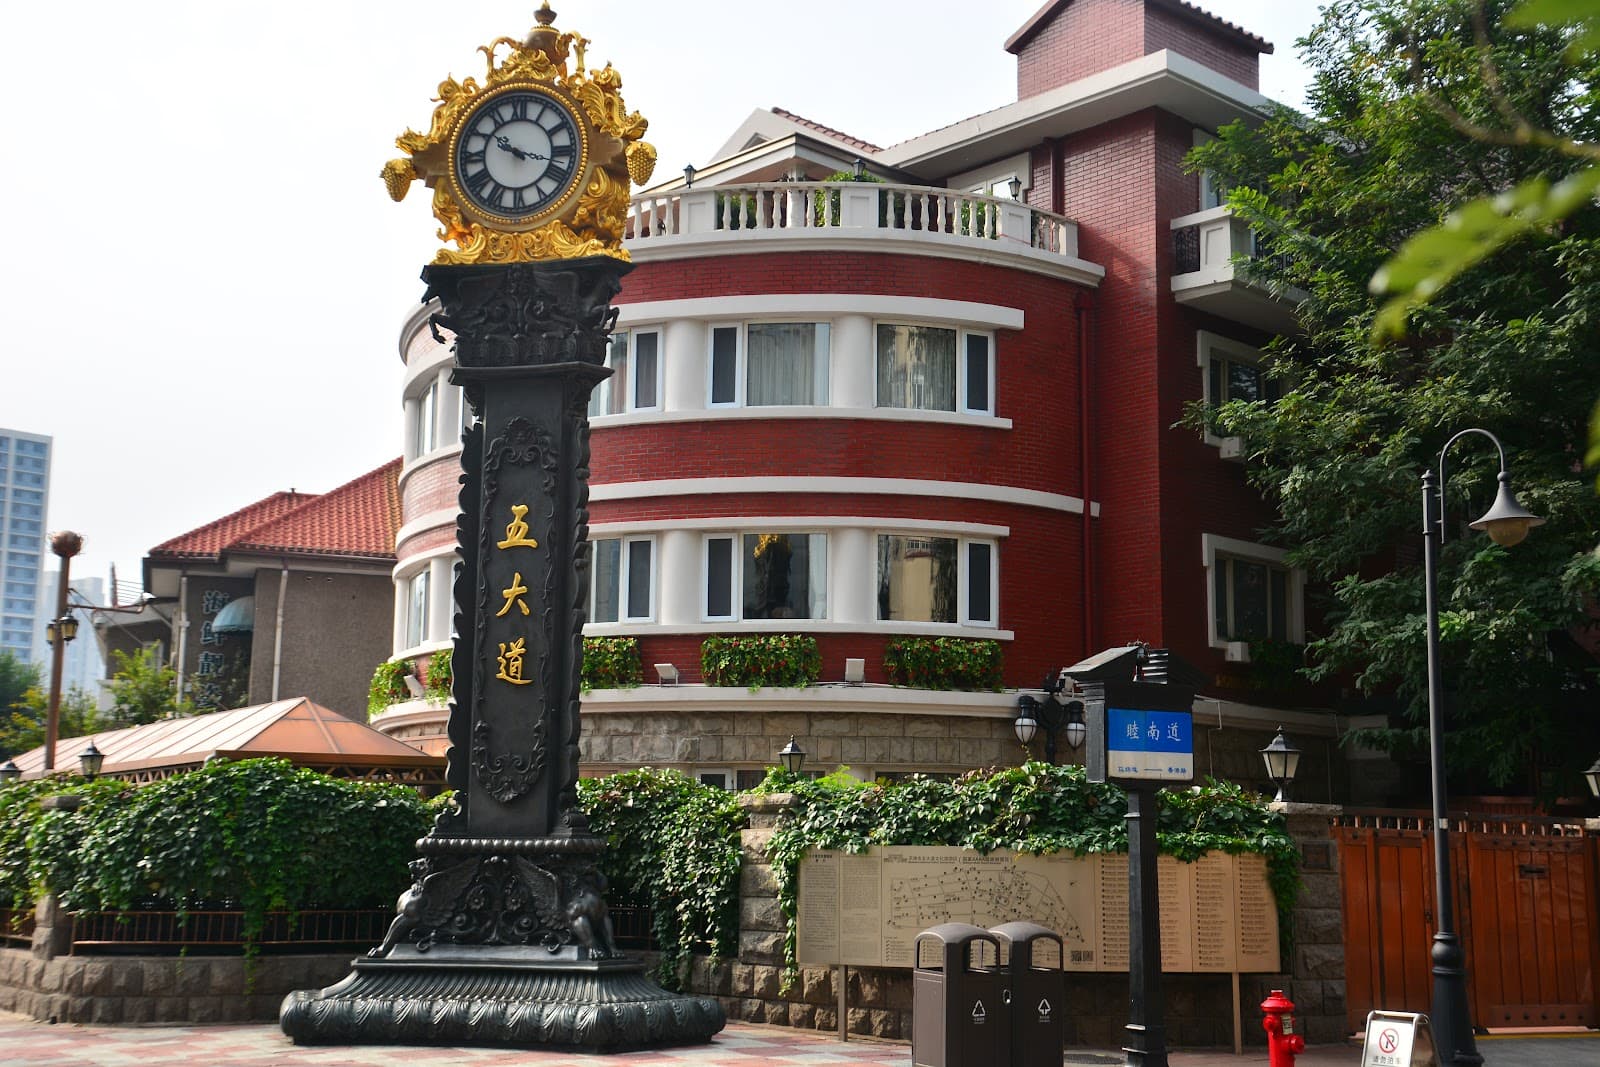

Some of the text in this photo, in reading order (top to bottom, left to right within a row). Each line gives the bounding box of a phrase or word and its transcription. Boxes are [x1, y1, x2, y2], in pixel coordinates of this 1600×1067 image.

[495, 503, 538, 686] 五大道
[1126, 720, 1182, 742] 睦南道
